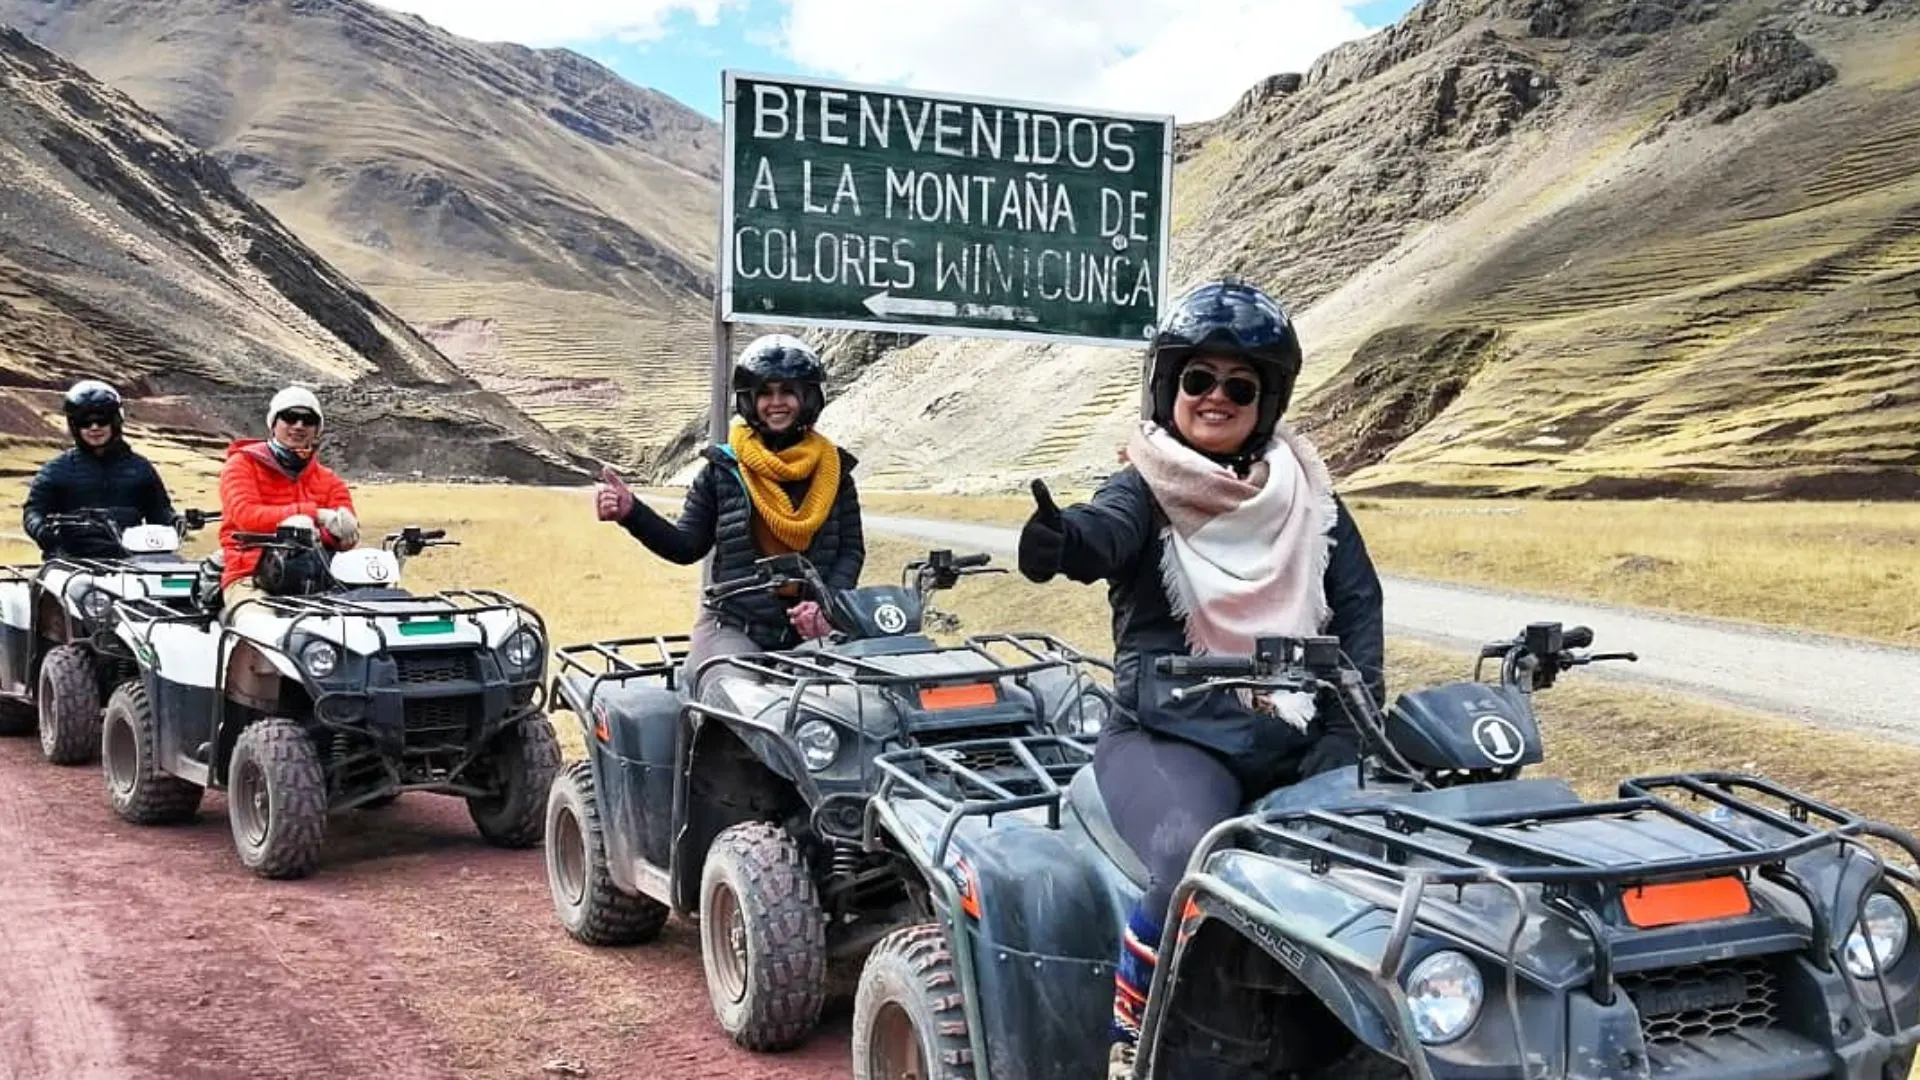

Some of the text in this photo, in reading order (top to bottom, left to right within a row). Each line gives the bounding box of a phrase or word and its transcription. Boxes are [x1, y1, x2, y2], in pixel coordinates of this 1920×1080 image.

[753, 84, 1135, 173] BIENVENIDOS
[748, 156, 1148, 241] A LA MONTAÑA DE
[735, 226, 1154, 307] COLORES WINICUNCA
[1483, 721, 1514, 756] 1
